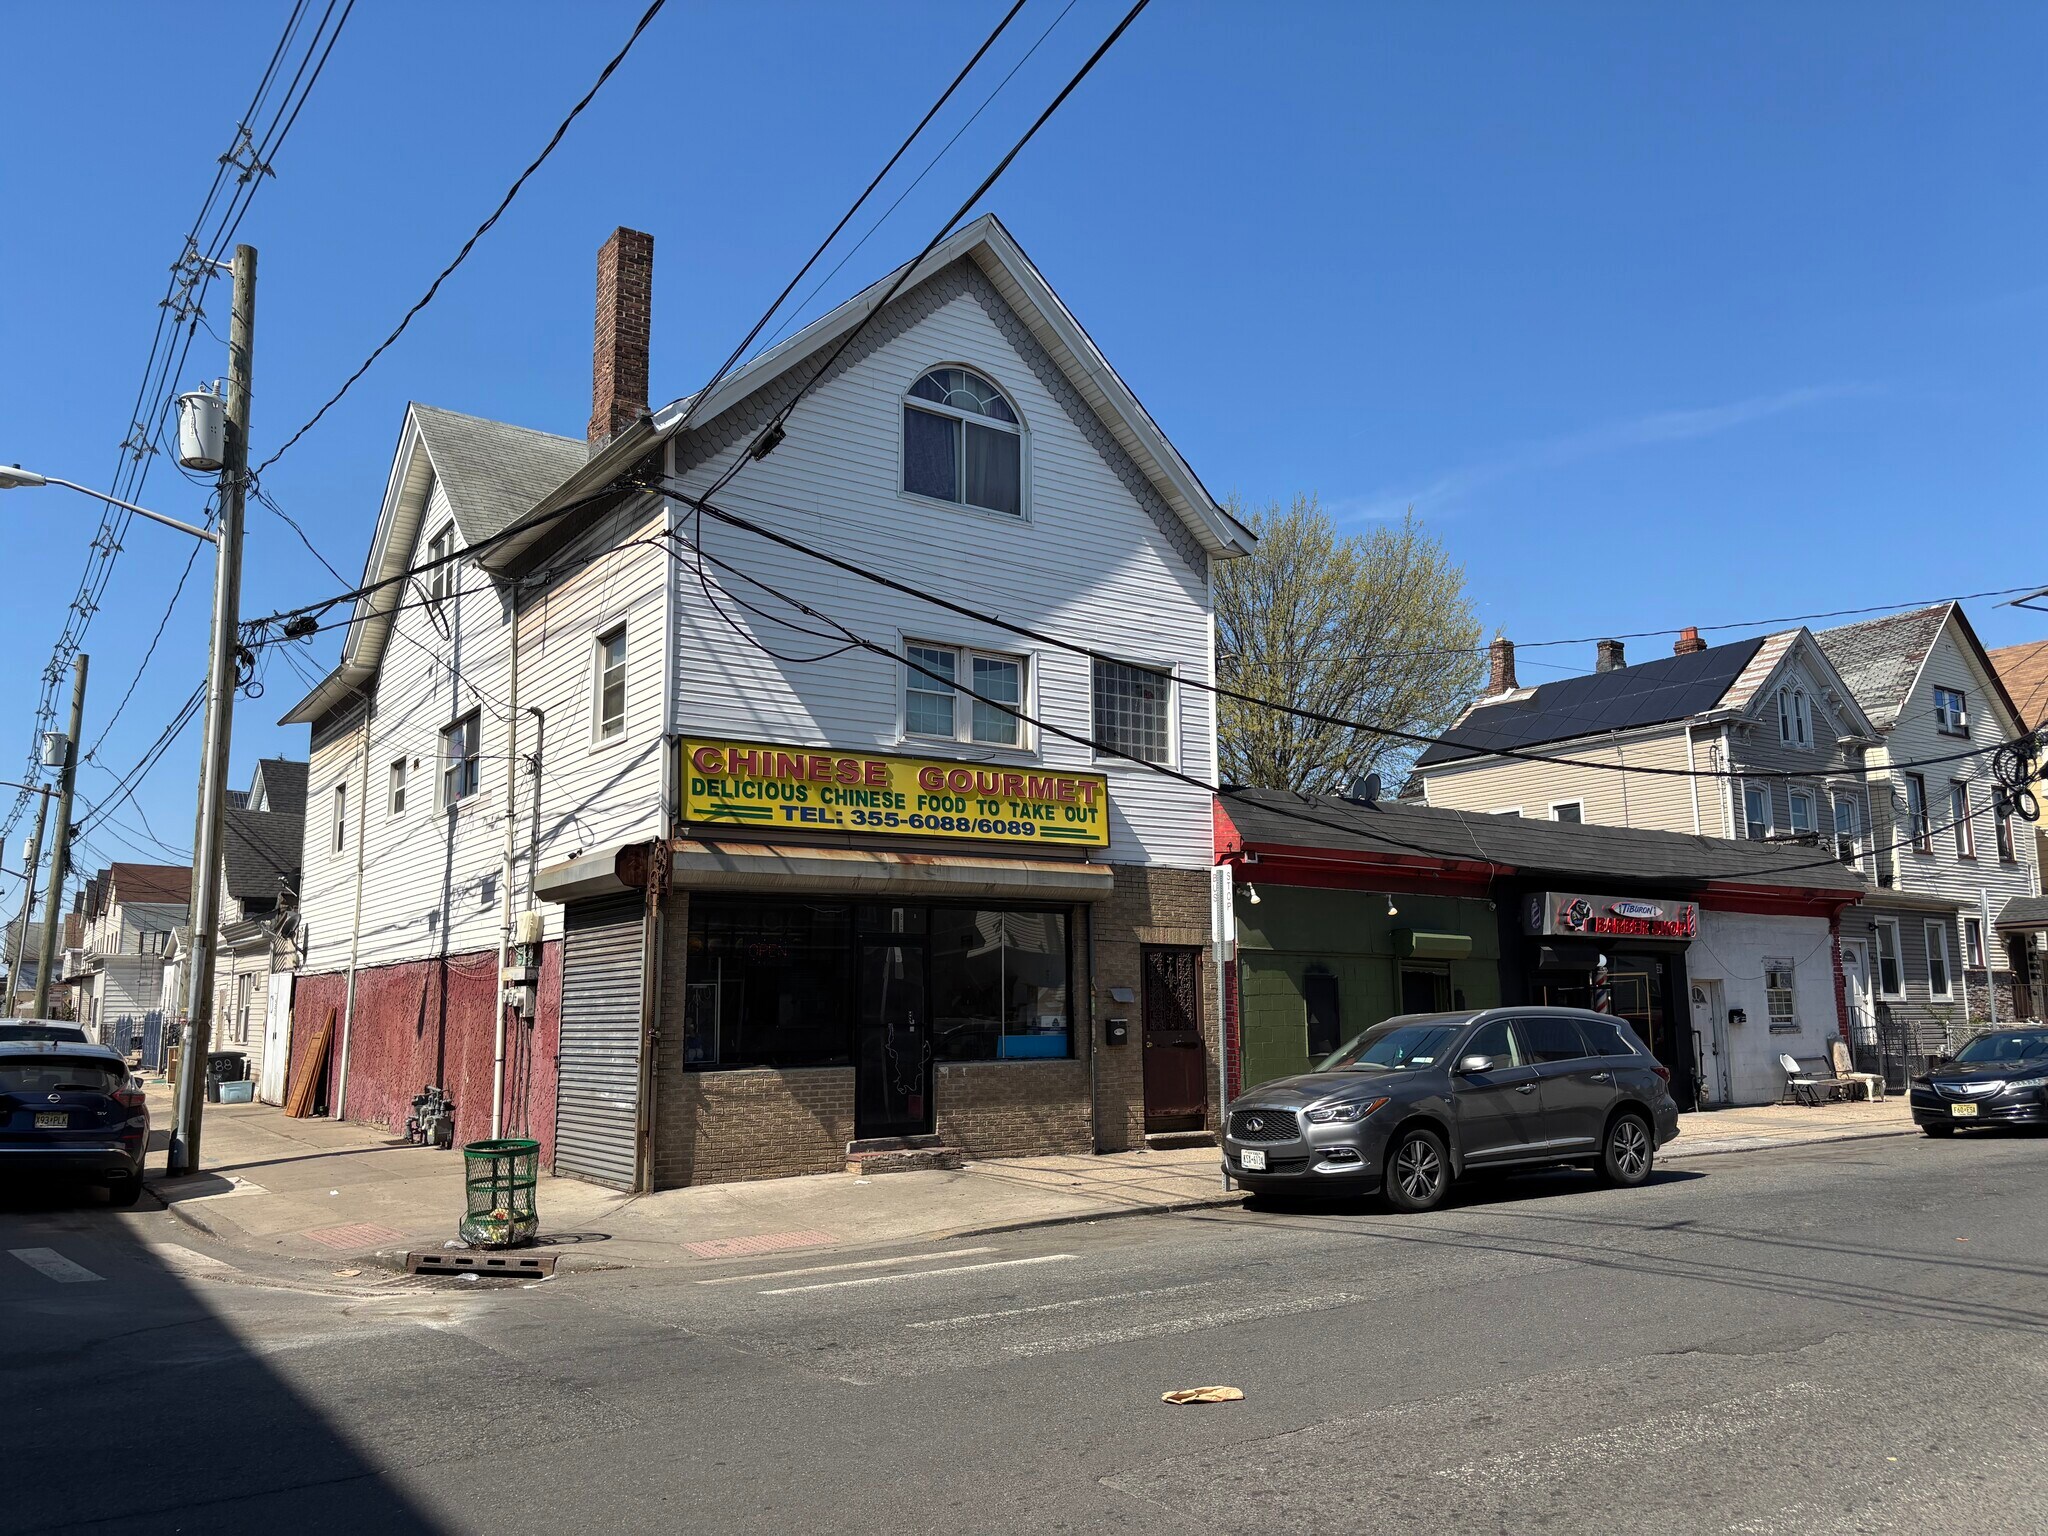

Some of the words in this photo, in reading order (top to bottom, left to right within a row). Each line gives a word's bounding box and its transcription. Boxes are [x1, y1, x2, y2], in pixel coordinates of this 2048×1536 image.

[693, 747, 888, 786] CHINESE
[918, 767, 1099, 804] GOURMET
[692, 779, 808, 802] DELICIOUS
[821, 789, 906, 809] CHINESE
[918, 796, 966, 813] FOOD
[978, 800, 999, 816] TO
[1010, 803, 1055, 820] TAKE
[1065, 806, 1098, 824] OUT
[780, 806, 843, 824] TEL:
[852, 810, 1036, 836] 355-6088/6089
[1595, 917, 1649, 935] BARBER
[1652, 921, 1685, 936] SHOP
[749, 943, 788, 958] OPEN
[215, 1058, 233, 1072] 88
